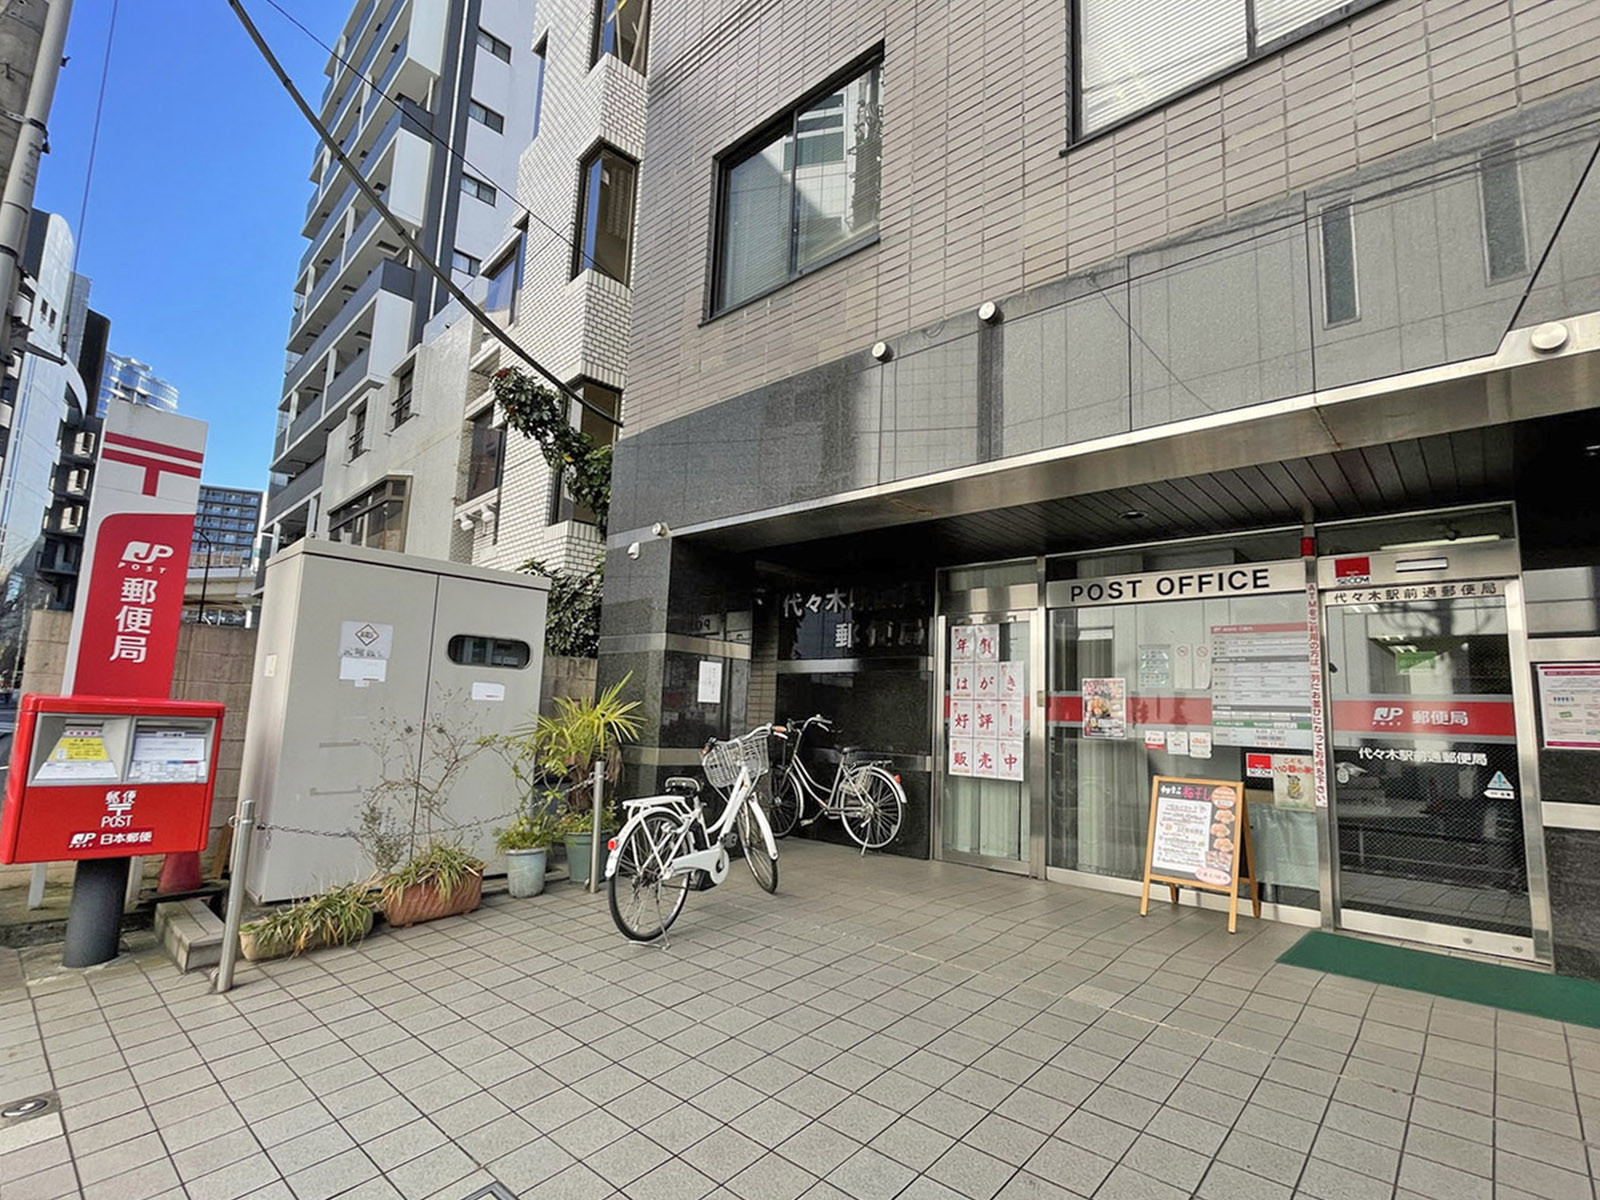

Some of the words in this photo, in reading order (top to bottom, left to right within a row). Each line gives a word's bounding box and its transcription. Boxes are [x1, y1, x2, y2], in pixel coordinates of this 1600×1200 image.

[1071, 579, 1142, 602] POST
[1156, 568, 1269, 596] OFFICE
[1334, 582, 1497, 604] 代々木駅前通郵便局
[110, 577, 158, 664] 郵便局
[957, 638, 993, 655] 年賀
[956, 676, 1016, 691] はがき
[1411, 709, 1469, 726] 郵便局
[953, 751, 1018, 771] 販売中
[1358, 747, 1488, 767] 代々木駅前通郵便局
[106, 790, 138, 805] 郵便
[101, 815, 134, 828] POST
[101, 831, 153, 846] 日本郵便
